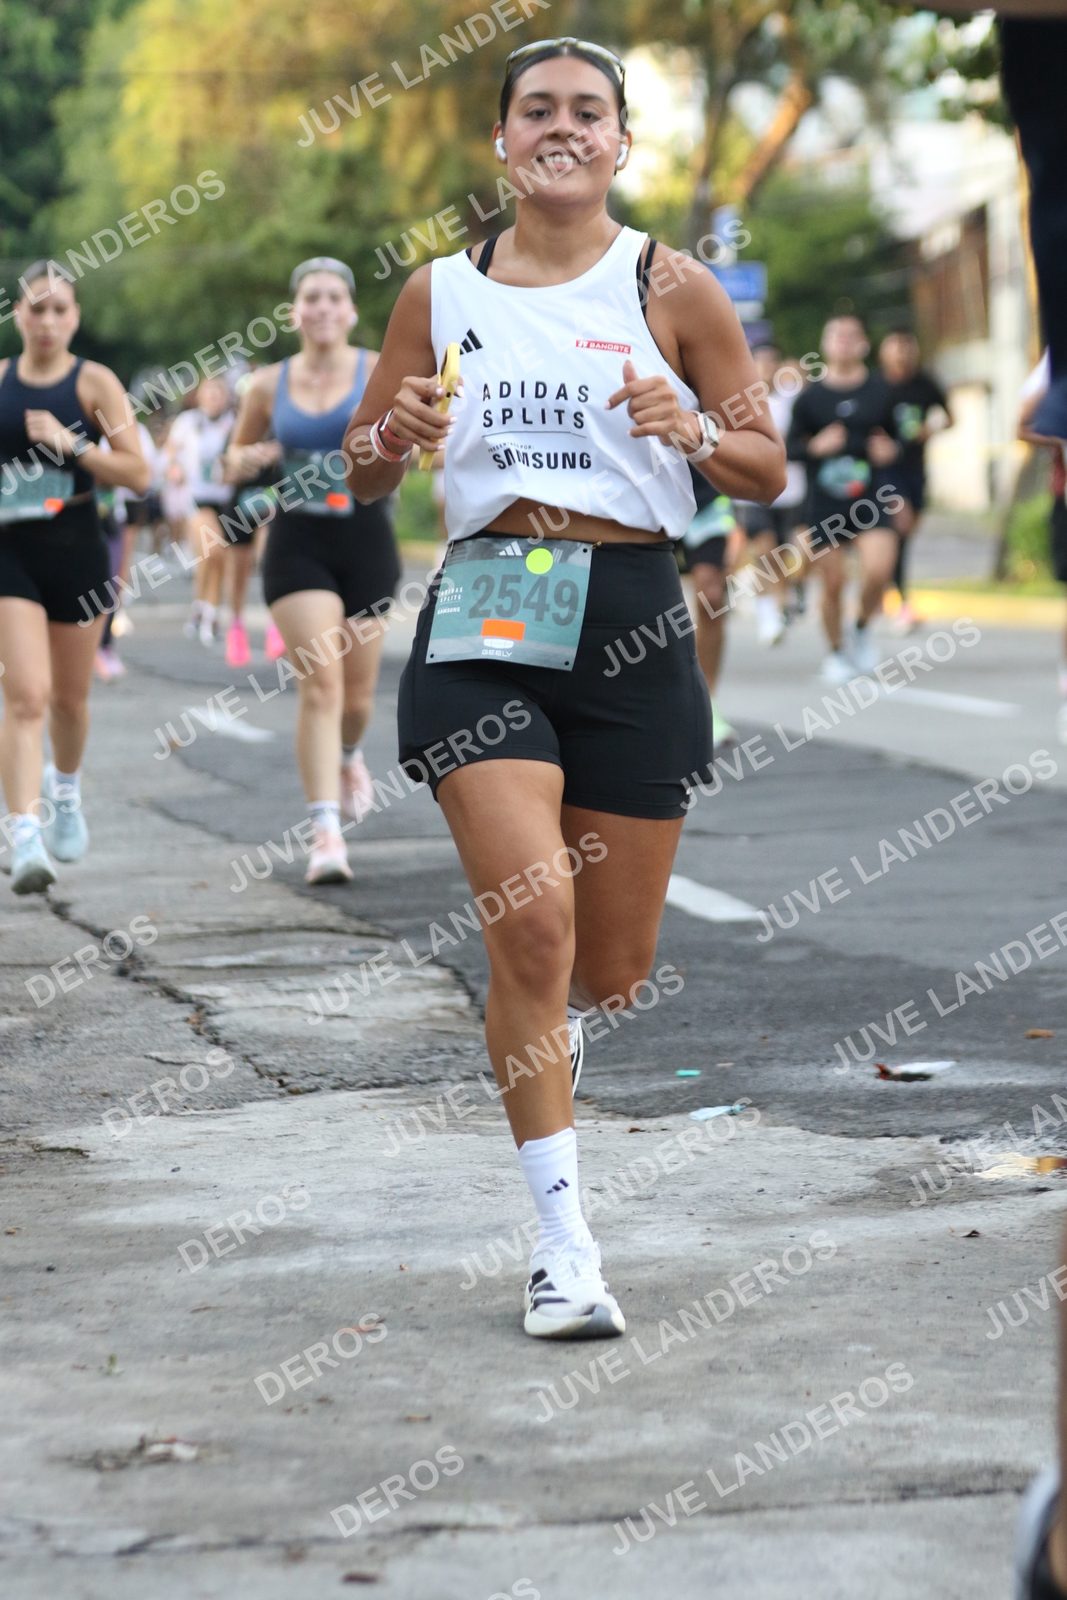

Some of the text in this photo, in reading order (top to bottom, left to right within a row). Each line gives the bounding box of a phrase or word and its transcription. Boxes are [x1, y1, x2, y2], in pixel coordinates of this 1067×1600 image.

[589, 341, 629, 353] BANORTE
[482, 380, 590, 403] ADIDAS
[482, 407, 585, 429] SPLITS
[492, 448, 592, 470] SAMSUNG
[468, 573, 579, 626] 2549
[481, 649, 512, 657] GEELY
